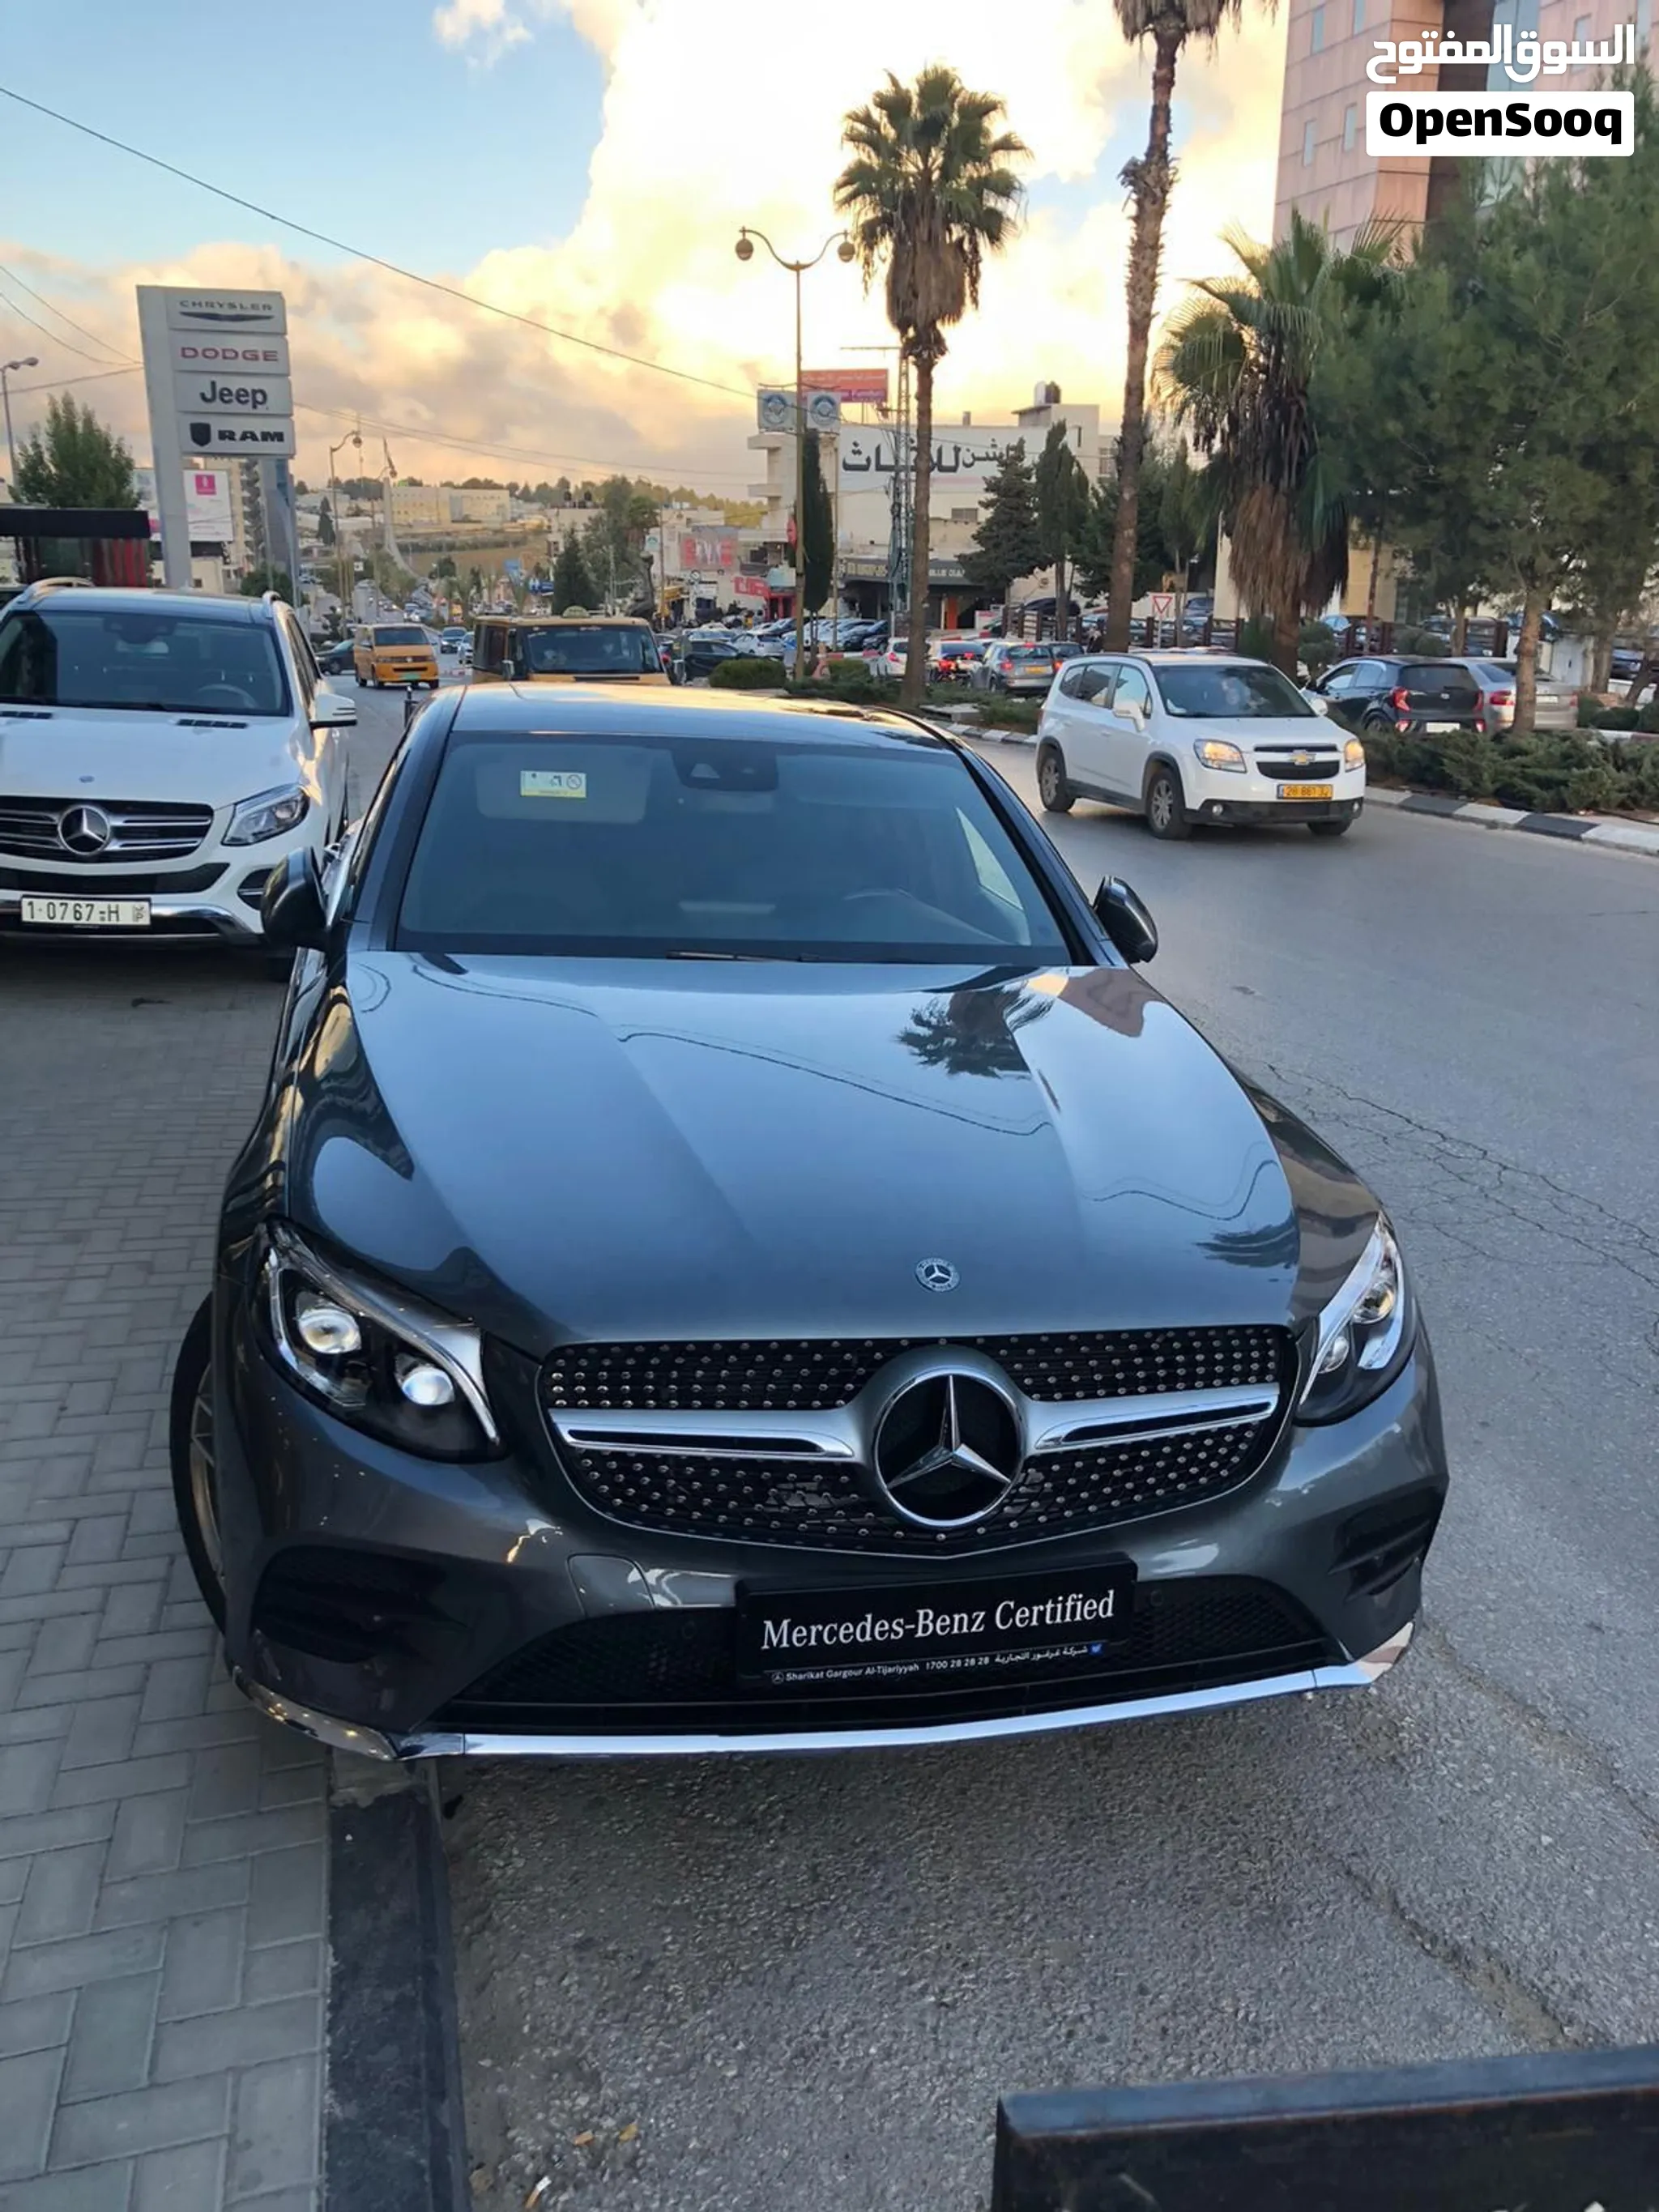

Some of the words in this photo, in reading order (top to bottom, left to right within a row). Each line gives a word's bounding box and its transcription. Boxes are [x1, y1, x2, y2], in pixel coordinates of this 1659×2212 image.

[179, 300, 273, 311] CHRYSLER
[181, 346, 279, 362] DODGE
[199, 379, 267, 410] Jeep
[218, 429, 285, 443] RAM
[761, 1608, 985, 1650] Mercedes-Benz
[995, 1589, 1115, 1630] Certified
[786, 1671, 824, 1681] Sharikat
[825, 1669, 863, 1679] Gargour
[925, 1660, 948, 1670] 1700
[950, 1659, 962, 1669] 28
[963, 1657, 975, 1667] 28
[978, 1656, 990, 1665] 28
